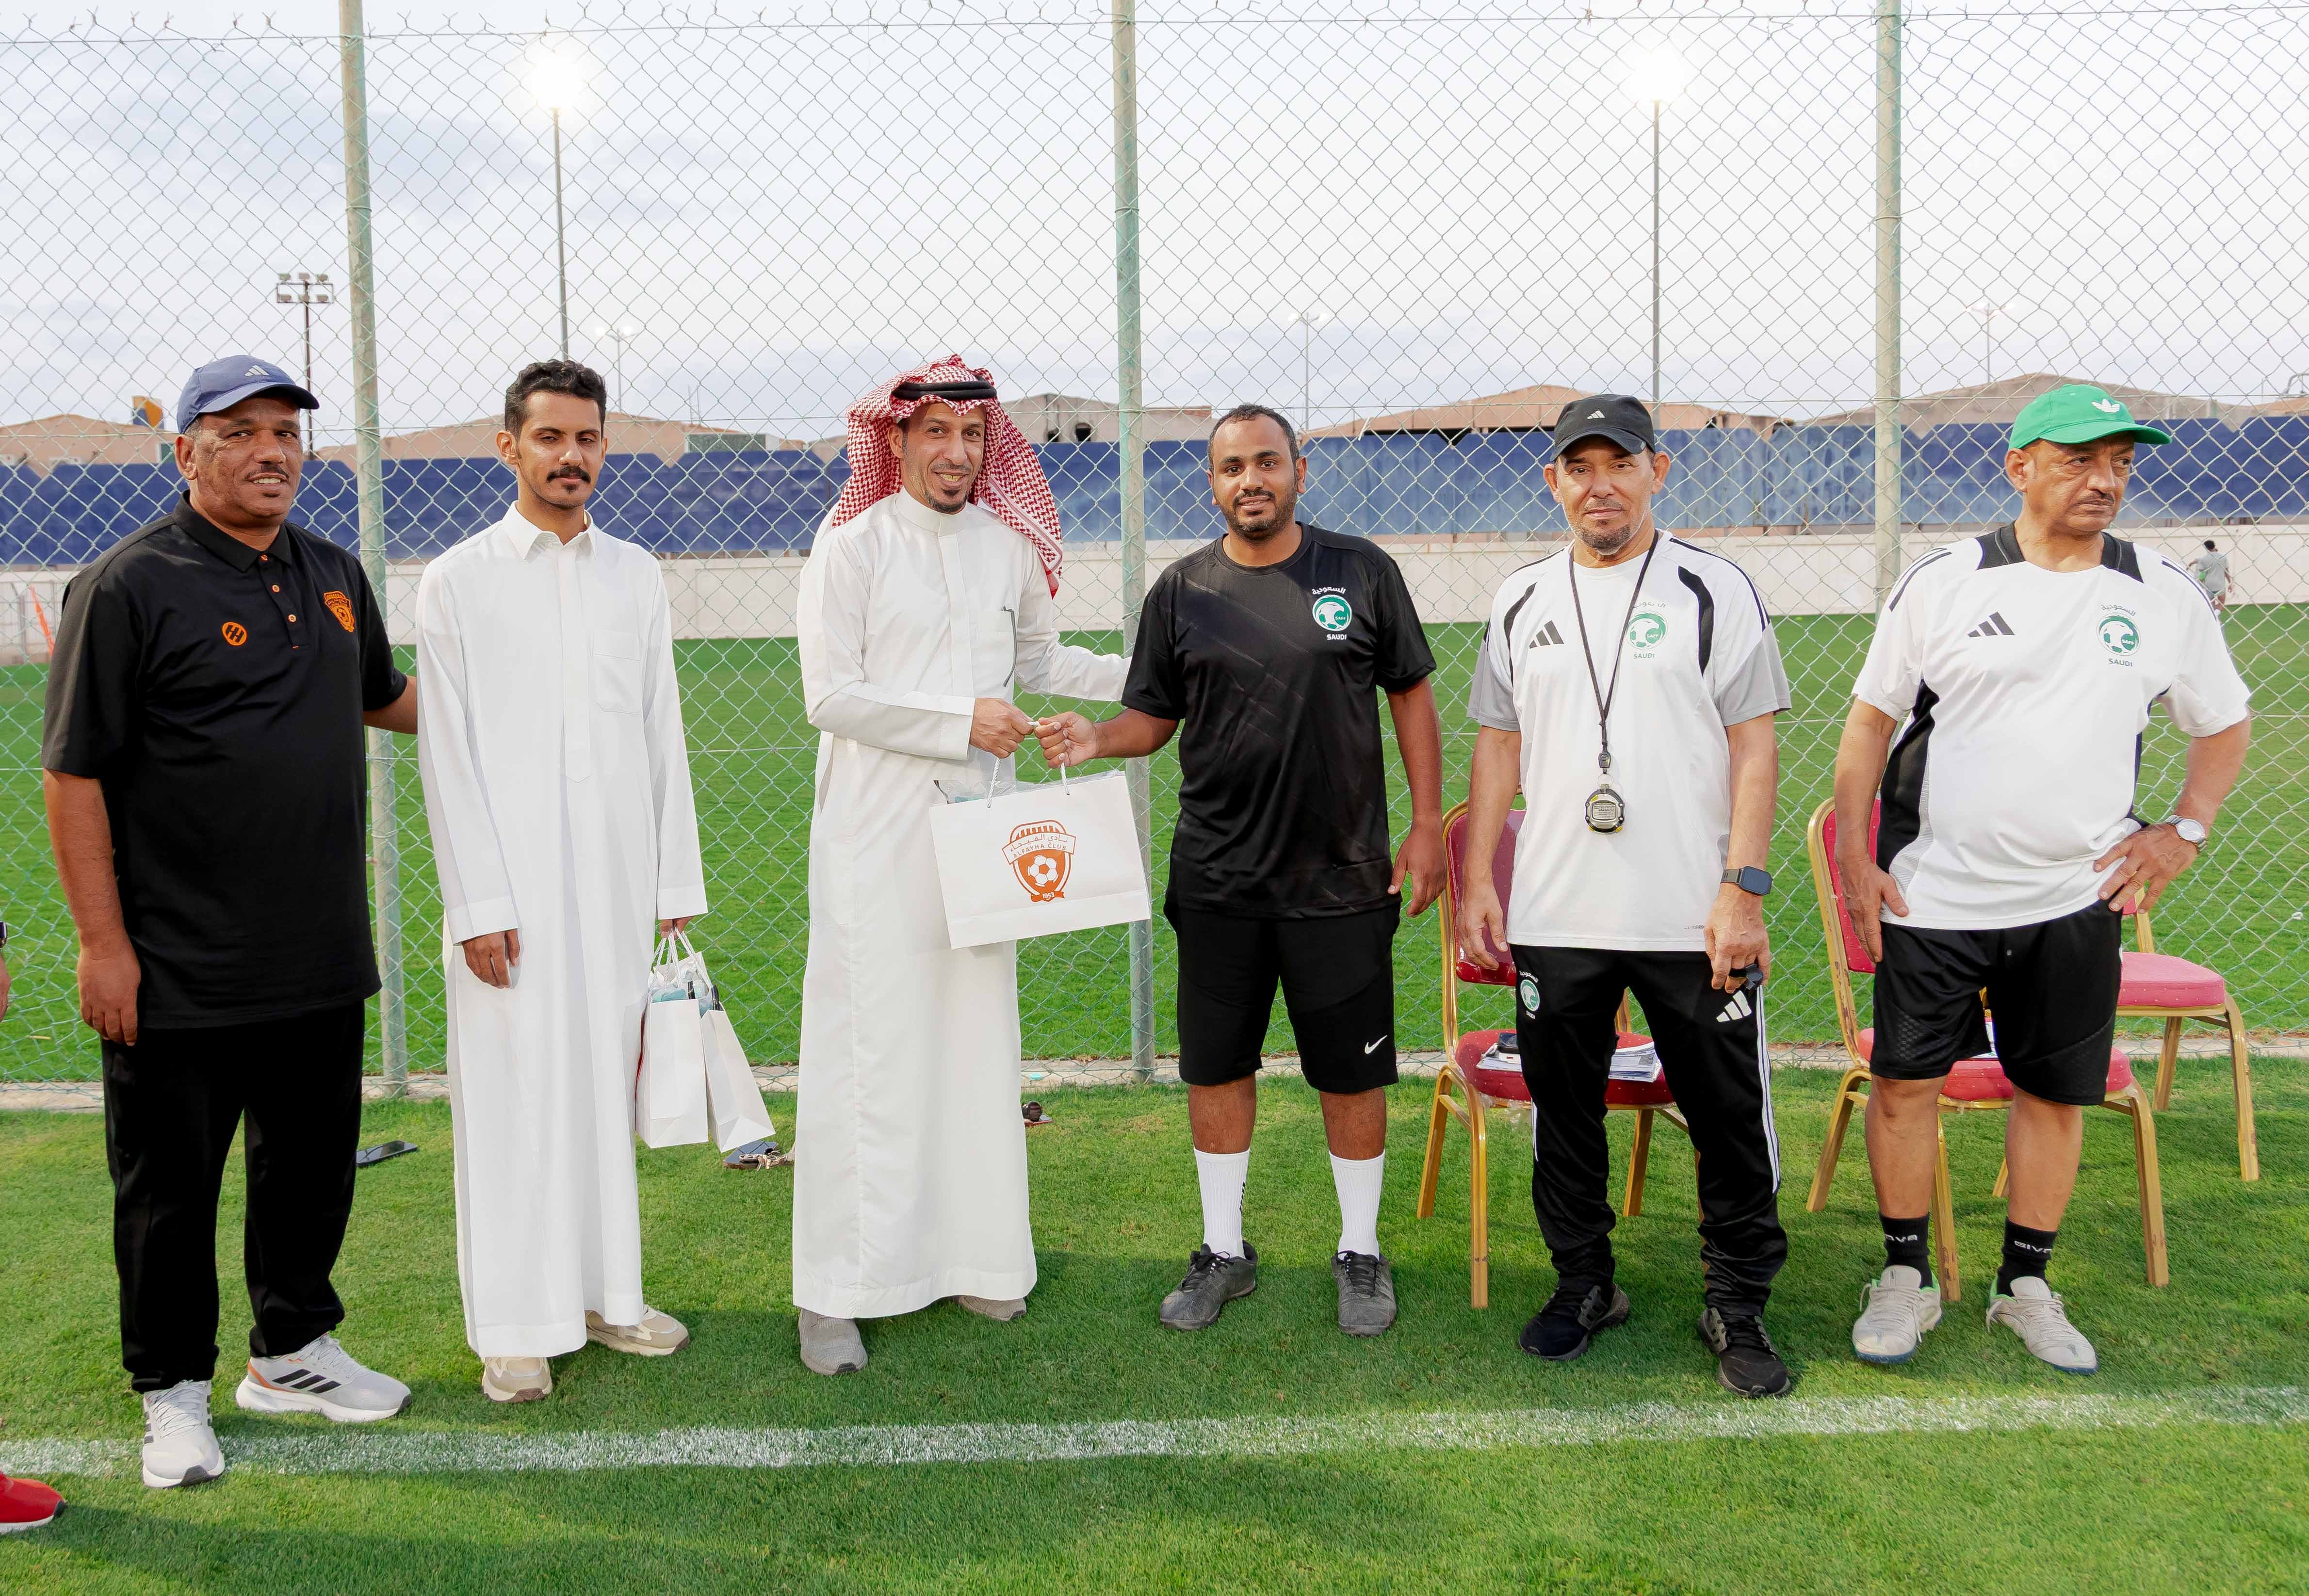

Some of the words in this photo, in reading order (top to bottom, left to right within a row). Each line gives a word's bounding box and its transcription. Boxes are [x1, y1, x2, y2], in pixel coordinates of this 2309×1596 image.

[1311, 586, 1346, 595] السعودية
[2101, 604, 2137, 616] السعودية
[2108, 658, 2133, 667] SAUDI
[1013, 843, 1044, 858] ALFAYHA
